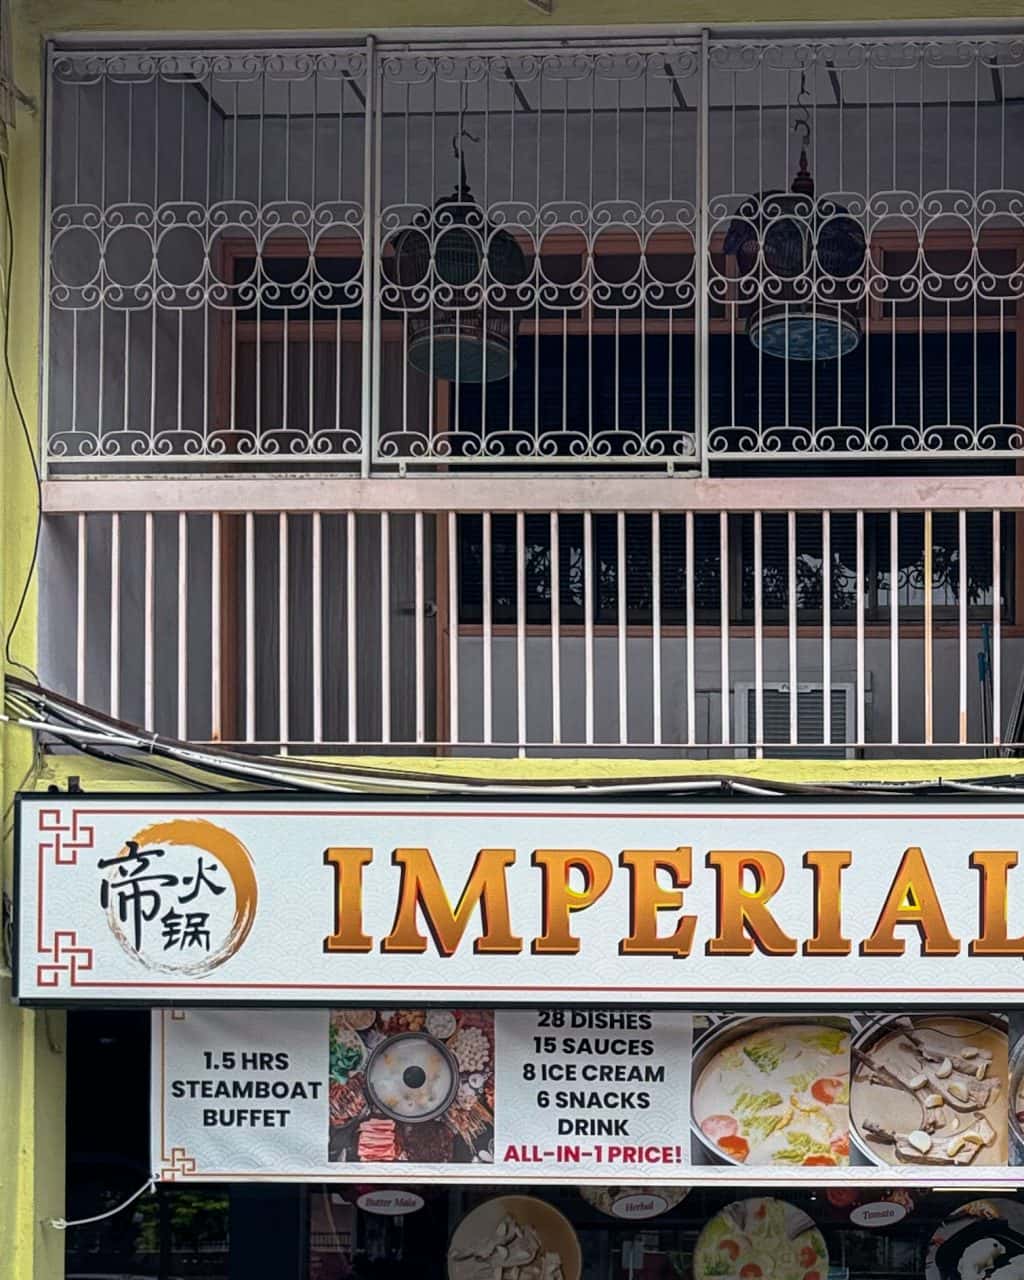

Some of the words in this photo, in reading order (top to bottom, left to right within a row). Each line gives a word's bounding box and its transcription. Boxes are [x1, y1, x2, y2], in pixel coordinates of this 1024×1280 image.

[537, 1012, 565, 1028] 28
[571, 1012, 652, 1030] DISHES
[533, 1036, 557, 1054] 15
[562, 1037, 654, 1056] SAUCES
[203, 1051, 237, 1071] 1.5
[241, 1051, 289, 1072] HRS
[522, 1063, 536, 1081] 8
[541, 1064, 577, 1081] ICE
[582, 1064, 665, 1082] CREAM
[171, 1079, 322, 1100] STEAMBOAT
[537, 1090, 550, 1108] 6
[555, 1091, 650, 1109] SNACKS
[203, 1108, 290, 1129] BUFFET
[558, 1118, 630, 1136] DRINK
[503, 1145, 602, 1163] ALL-IN-1
[608, 1145, 682, 1163] PRICE!
[625, 1200, 654, 1212] Herbal
[863, 1208, 895, 1221] Tomato
